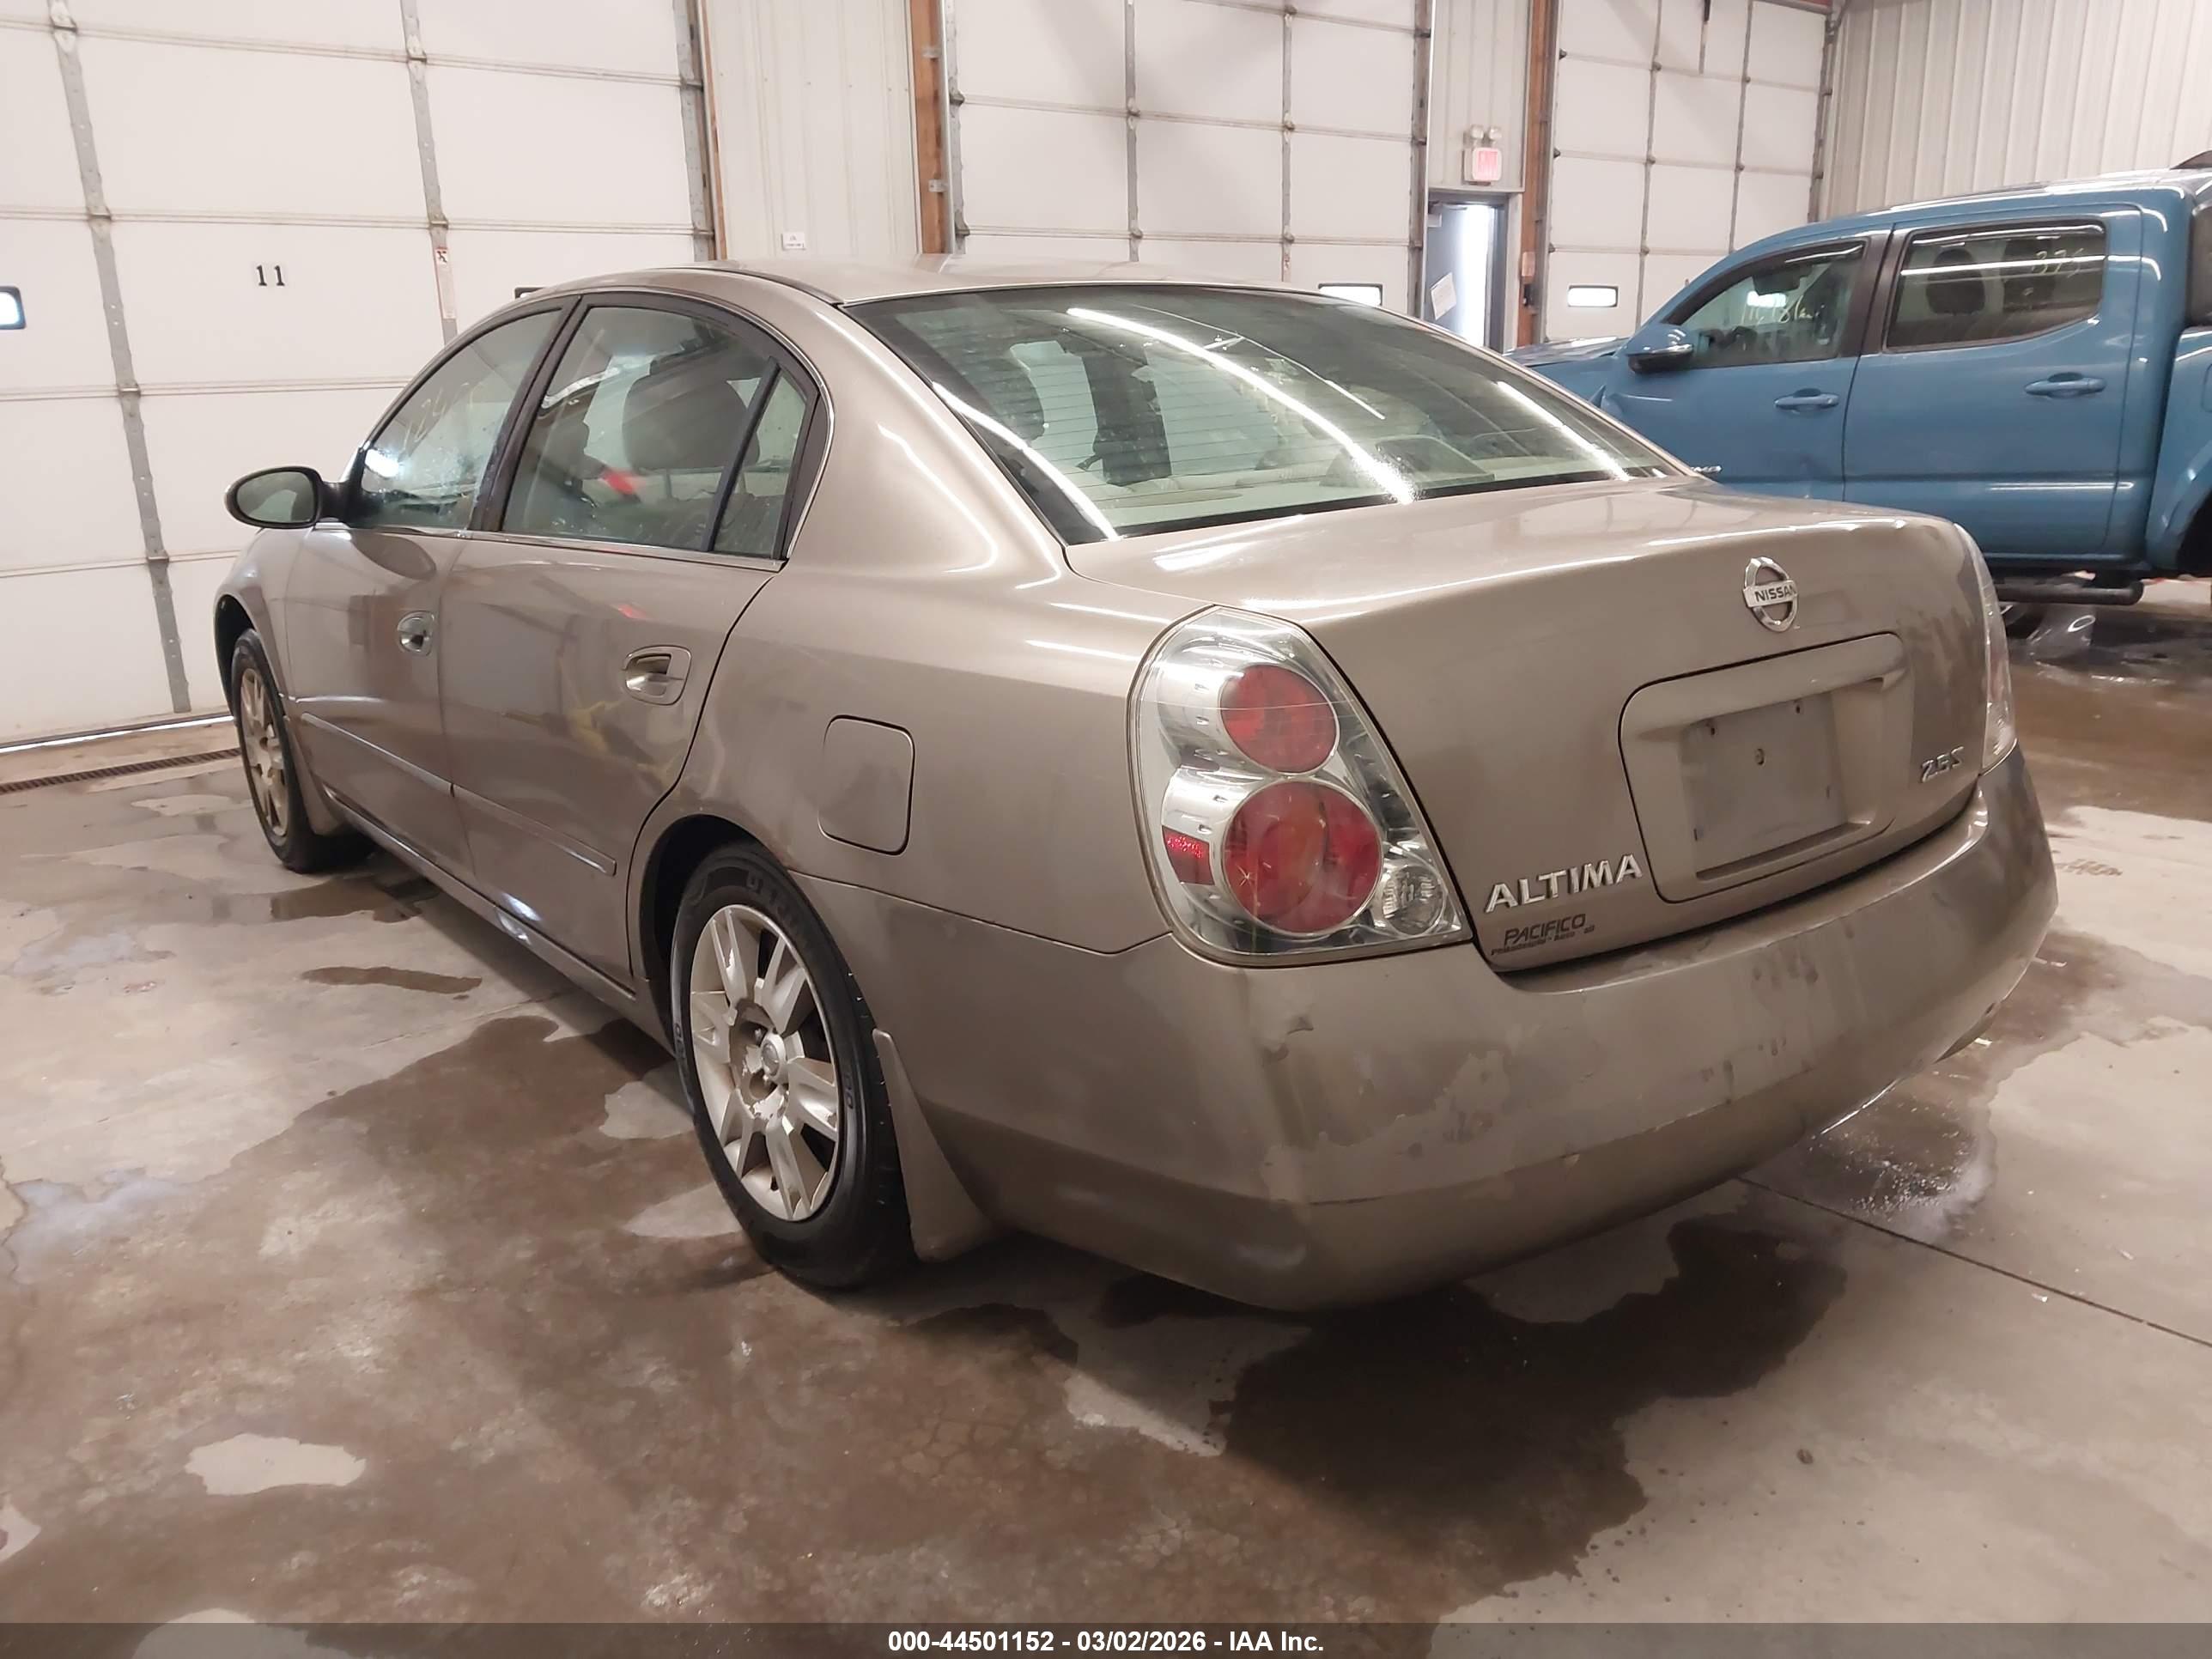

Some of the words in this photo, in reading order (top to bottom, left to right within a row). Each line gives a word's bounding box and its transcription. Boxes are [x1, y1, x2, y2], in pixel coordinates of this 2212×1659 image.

[256, 264, 285, 287] 11
[1484, 854, 1643, 913] ALTIMA
[1504, 913, 1586, 946] PACIFICO
